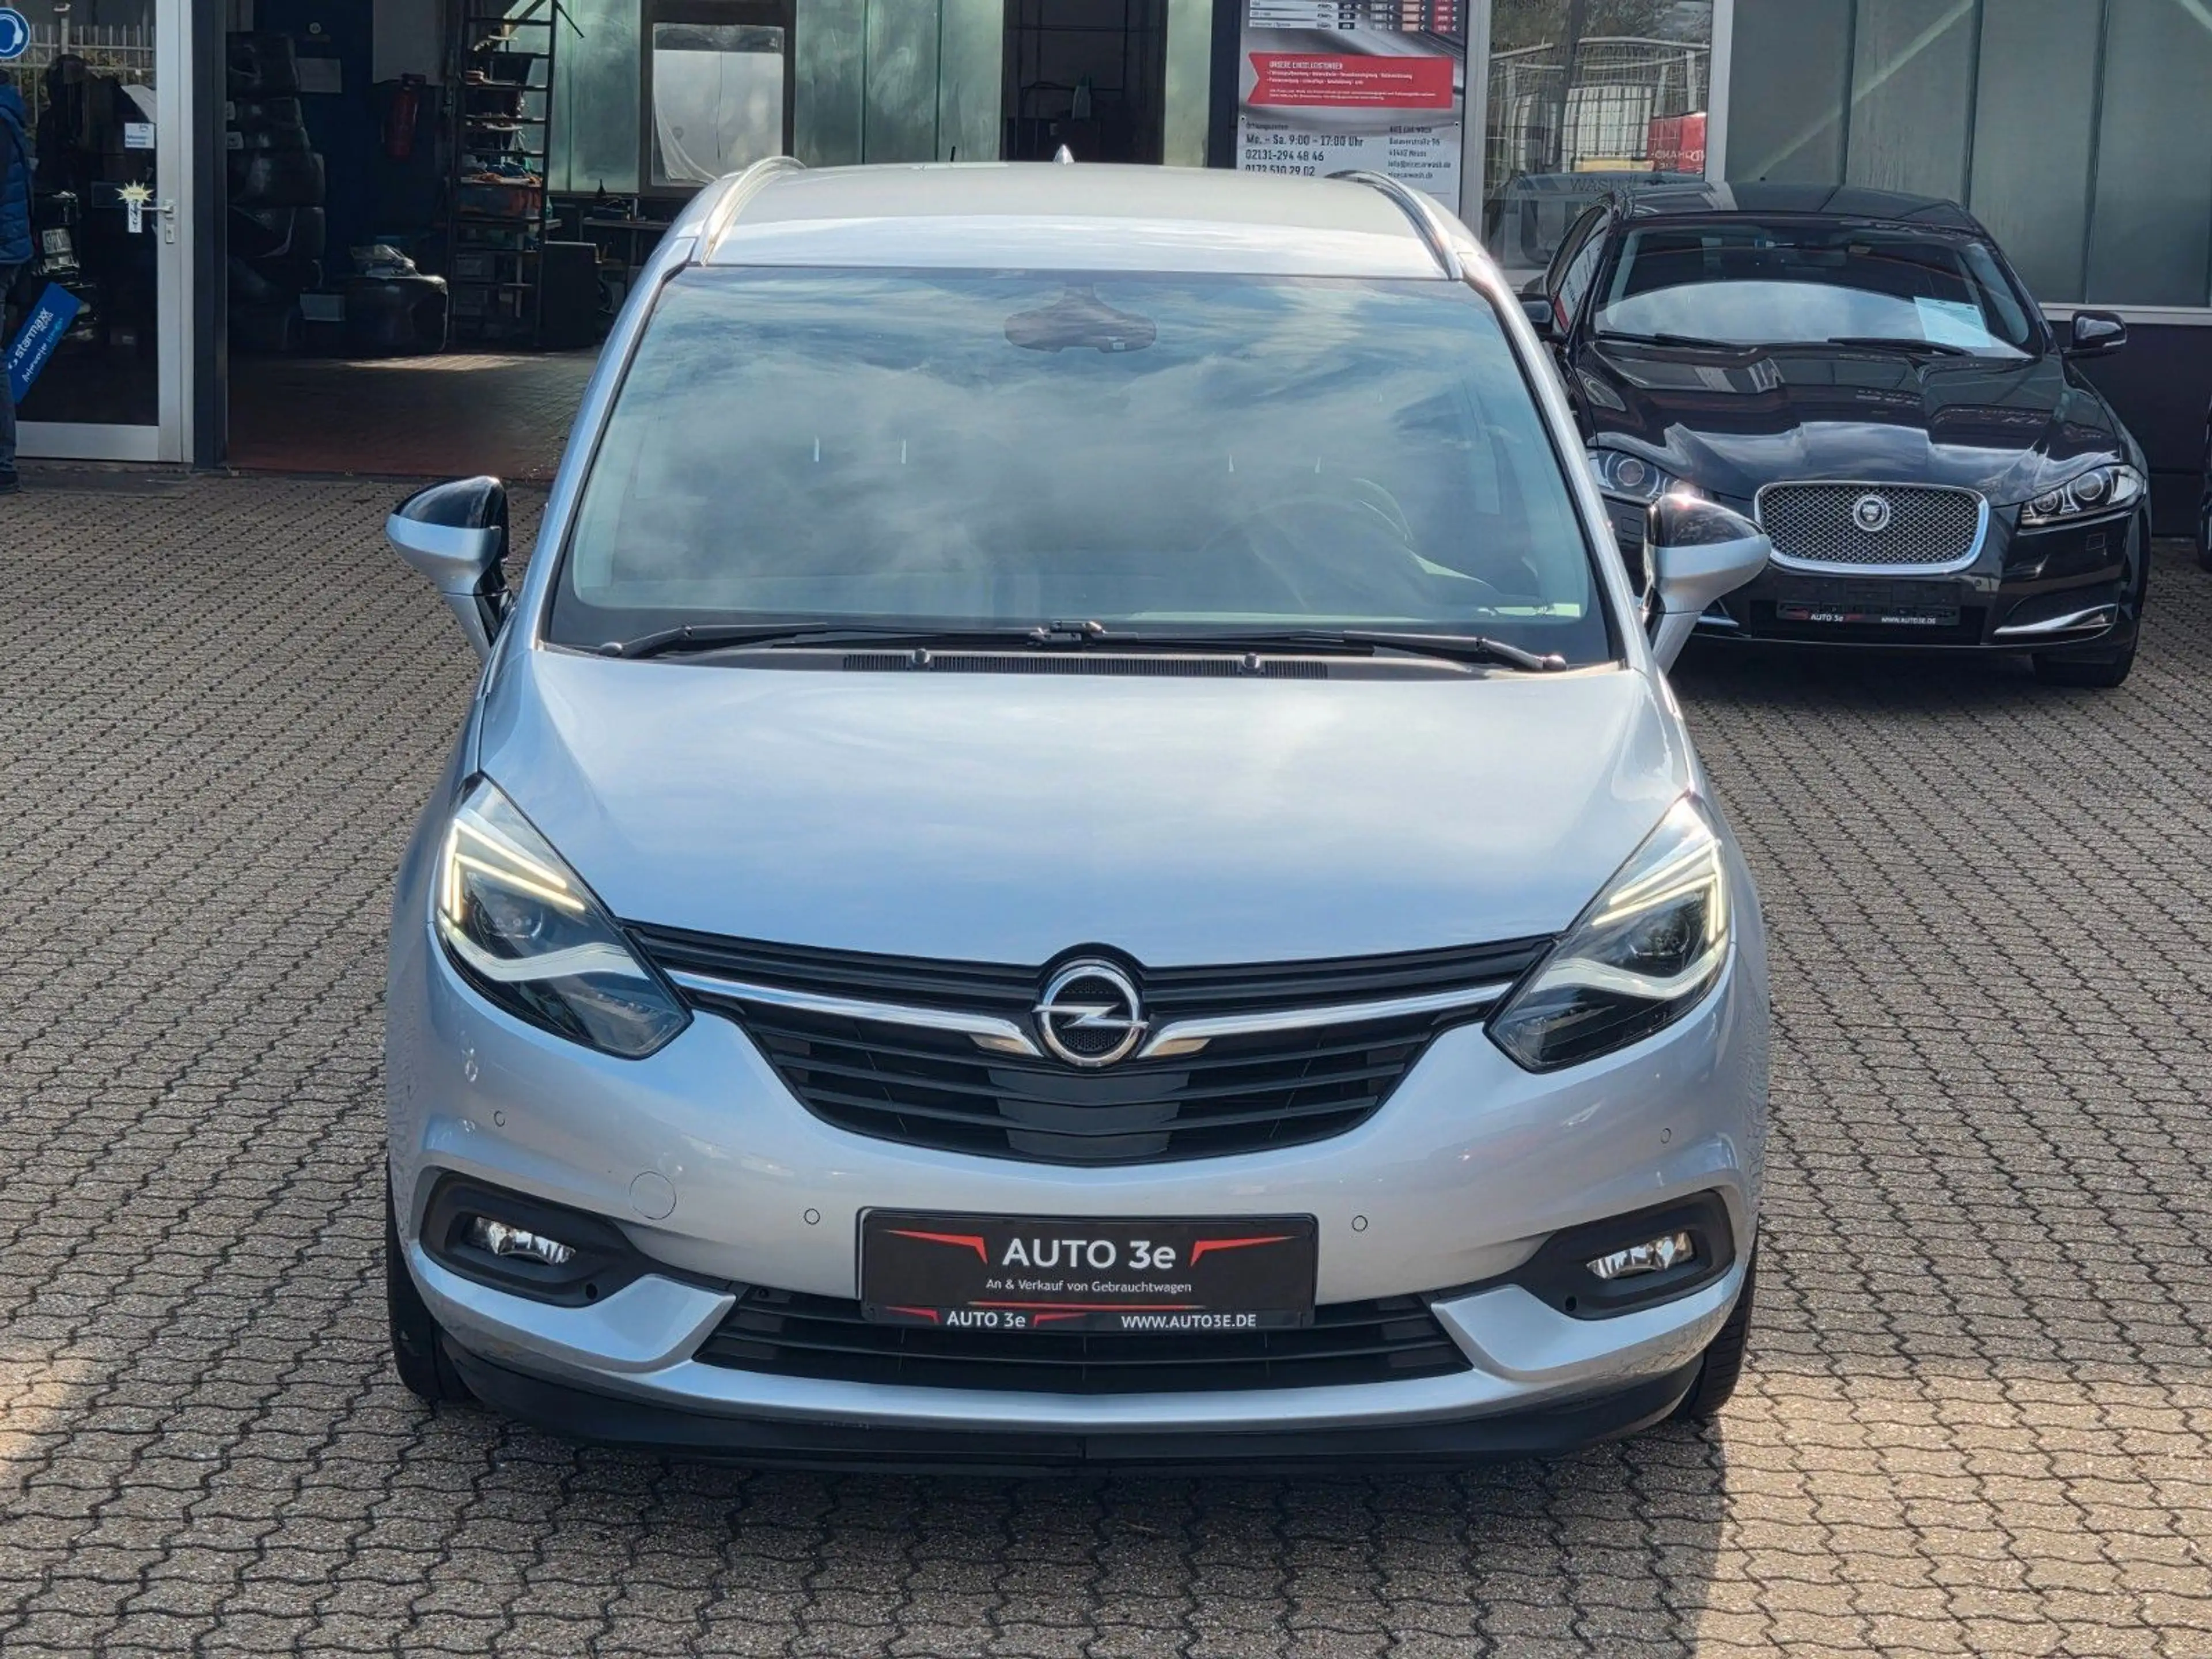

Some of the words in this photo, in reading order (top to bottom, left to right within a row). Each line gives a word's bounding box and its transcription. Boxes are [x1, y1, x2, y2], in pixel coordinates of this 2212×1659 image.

[1289, 135, 1310, 145] 9:00
[1321, 135, 1346, 146] 17:00
[1349, 136, 1363, 146] Uhr
[1002, 1238, 1117, 1268] AUTO
[1128, 1240, 1176, 1268] 3e
[986, 1278, 1002, 1289] An
[1005, 1279, 1014, 1290] &
[1018, 1279, 1063, 1291] Verkauf
[1067, 1282, 1088, 1291] von
[1092, 1281, 1192, 1294] Gebrauchtwagen
[946, 1311, 998, 1325] AUTO
[1004, 1313, 1026, 1327] 3e
[1122, 1313, 1256, 1328] WWW.AUTO3E.DE
